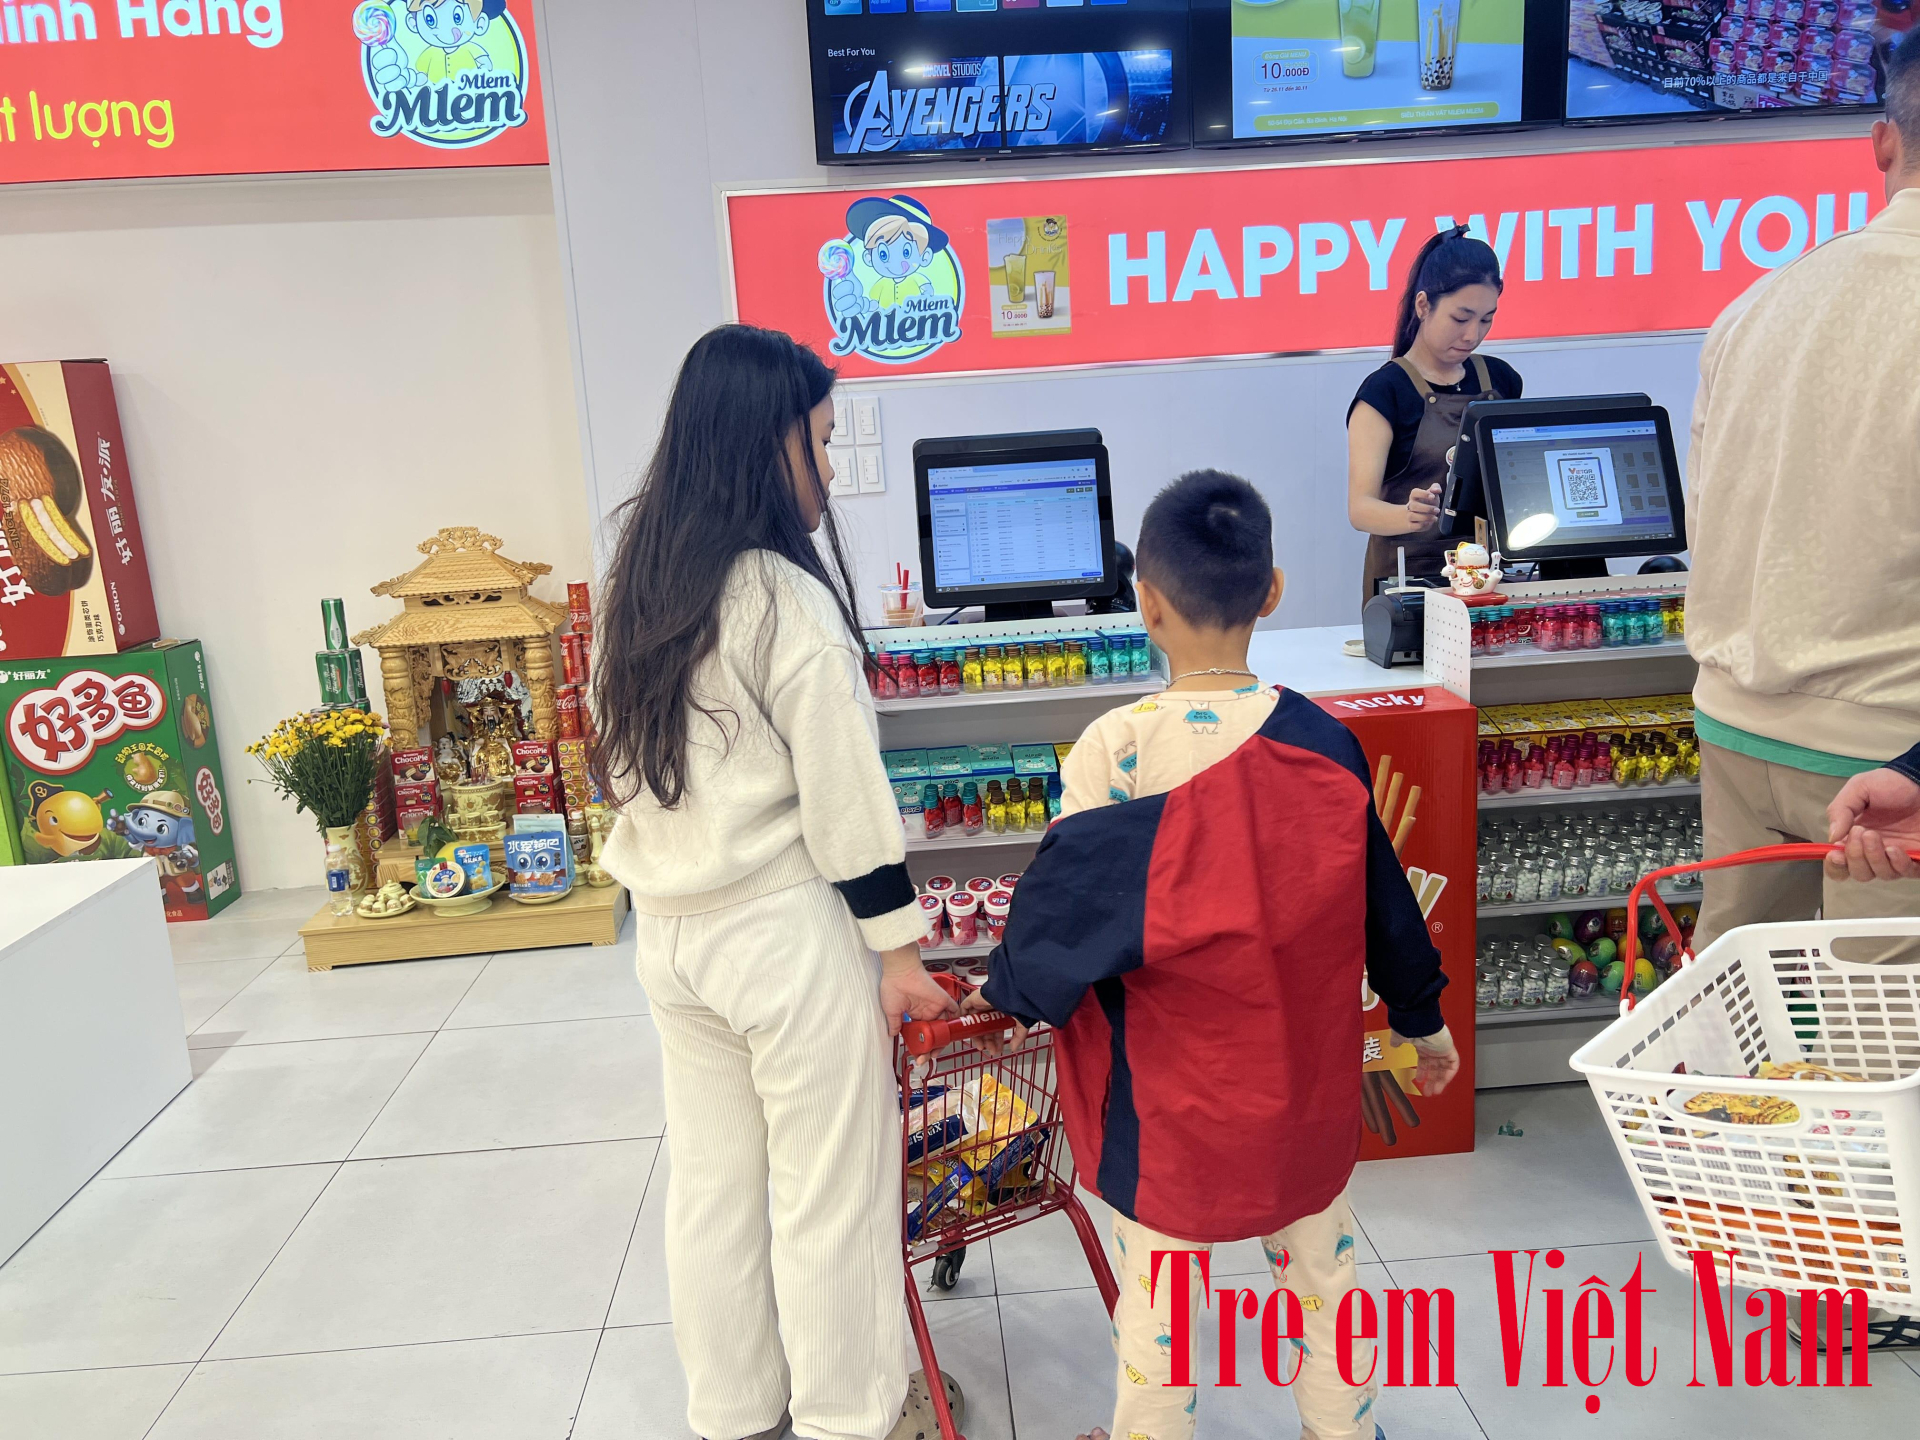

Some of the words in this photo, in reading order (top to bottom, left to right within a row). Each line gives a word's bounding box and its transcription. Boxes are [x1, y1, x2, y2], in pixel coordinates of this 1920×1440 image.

[828, 48, 845, 57] Best
[846, 48, 860, 56] For
[861, 47, 876, 56] You
[922, 63, 950, 77] MARVEL
[952, 62, 982, 76] STUDIOS
[458, 72, 511, 91] Mlem
[1663, 71, 1828, 89] 目前70%以上的商品都是来自于中国
[375, 83, 521, 131] Mlem
[846, 70, 1056, 153] AVENGERS
[29, 90, 174, 149] lượng
[998, 232, 1032, 247] Happy
[1026, 242, 1062, 255] Drinks
[1108, 217, 1406, 305] HAPPY
[904, 298, 949, 314] Mlem
[833, 307, 956, 350] Mlem
[0, 478, 12, 509] 1974
[4, 511, 22, 549] SINCE
[110, 581, 123, 624] ORION
[13, 670, 48, 681] 好丽友
[1333, 693, 1425, 711] Pocky
[18, 677, 152, 763] 好多鱼
[395, 754, 428, 764] ChocoPie
[198, 771, 222, 830] 好多鱼
[397, 788, 421, 796] ChocoPie
[960, 1011, 1005, 1027] Mlem
